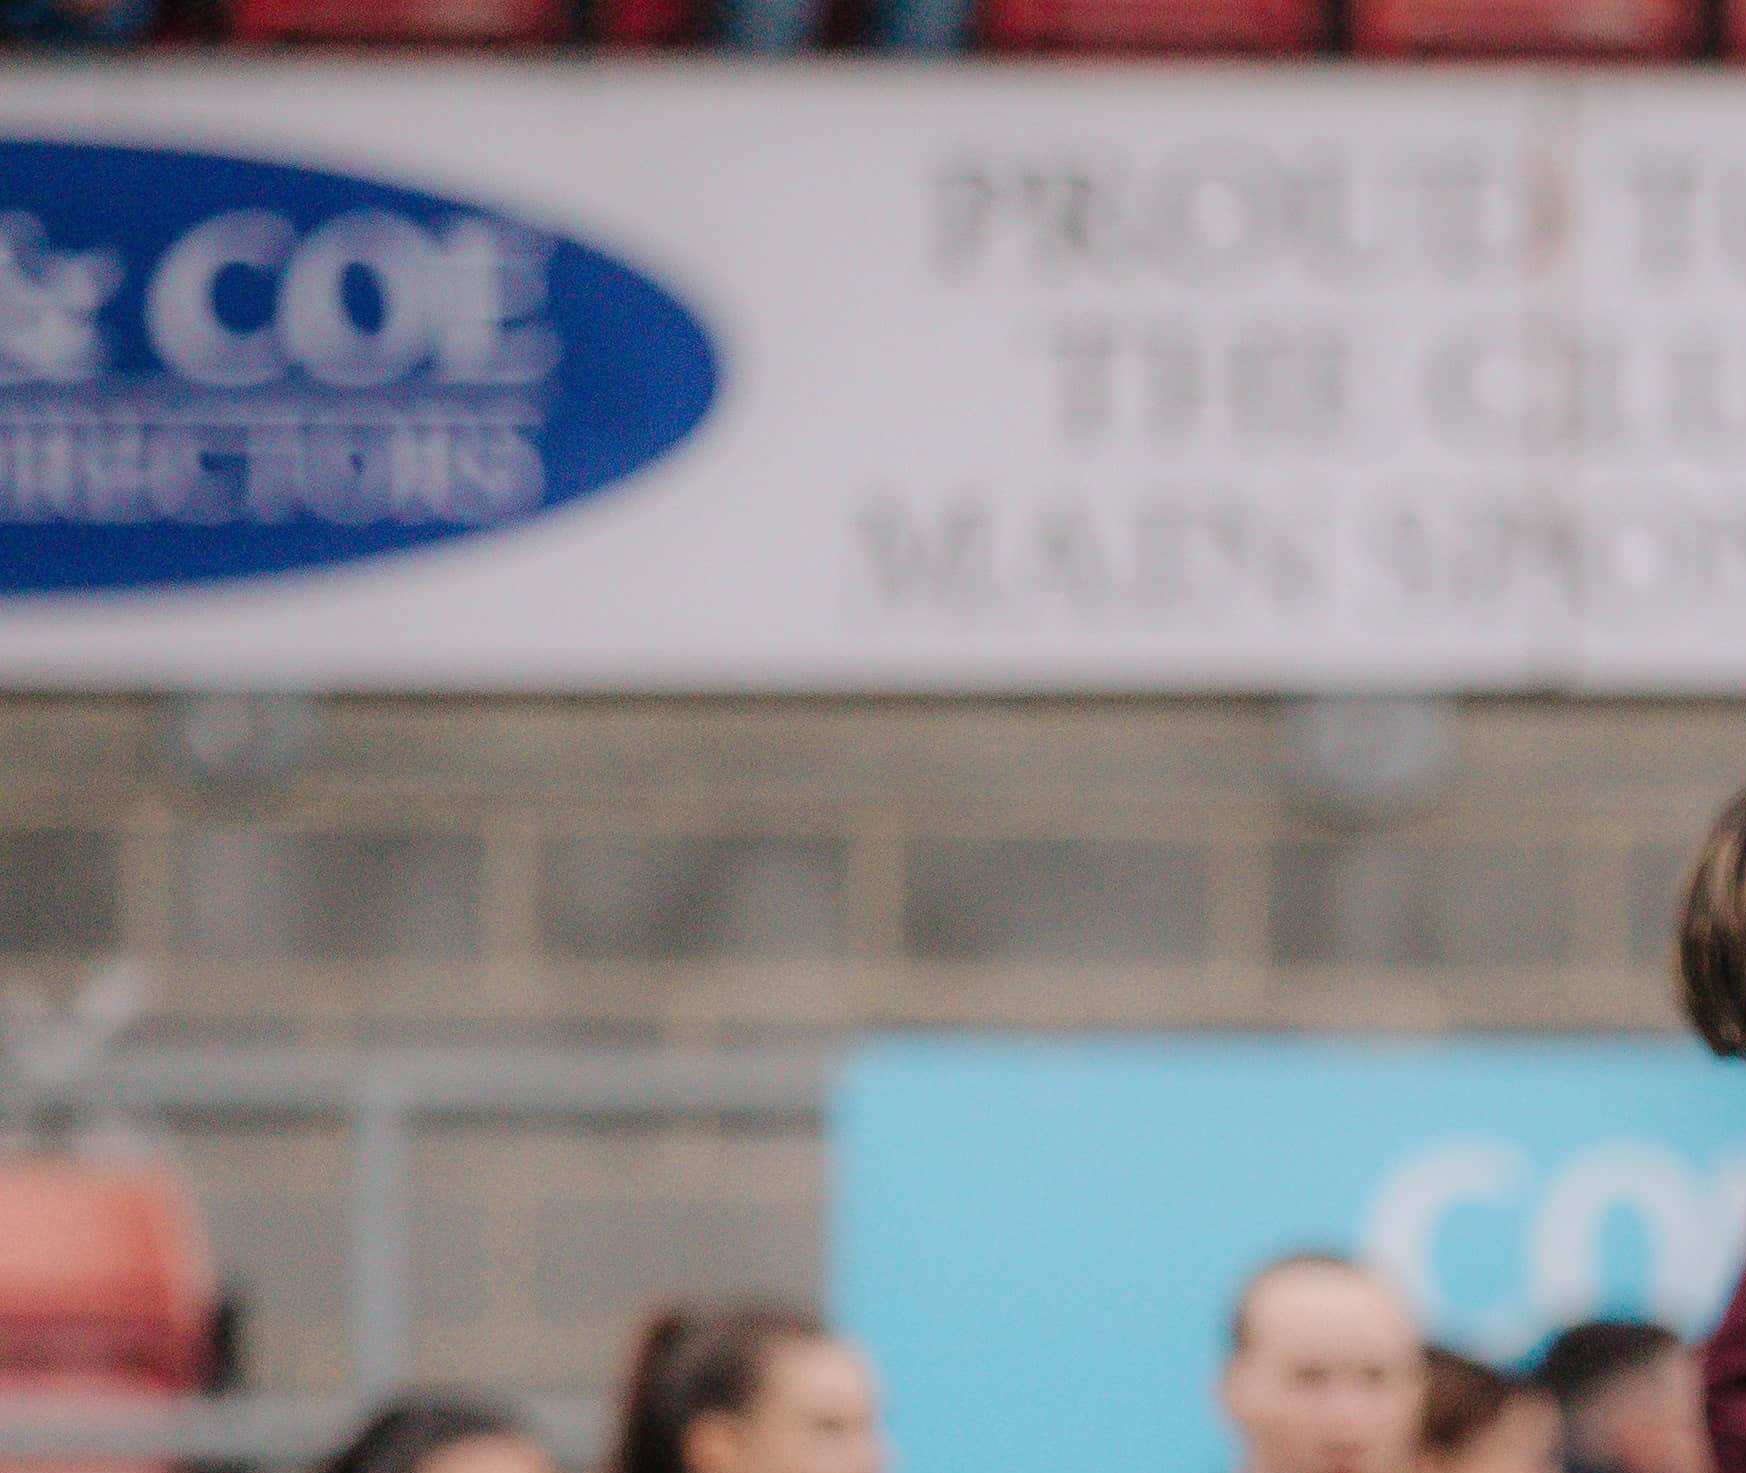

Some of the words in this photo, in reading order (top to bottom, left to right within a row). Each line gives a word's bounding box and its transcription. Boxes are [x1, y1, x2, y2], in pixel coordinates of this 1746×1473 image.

[926, 143, 1555, 290] PROUD
[147, 208, 560, 390] COE
[1035, 315, 1365, 457] THE
[848, 482, 1327, 620] MAIN
